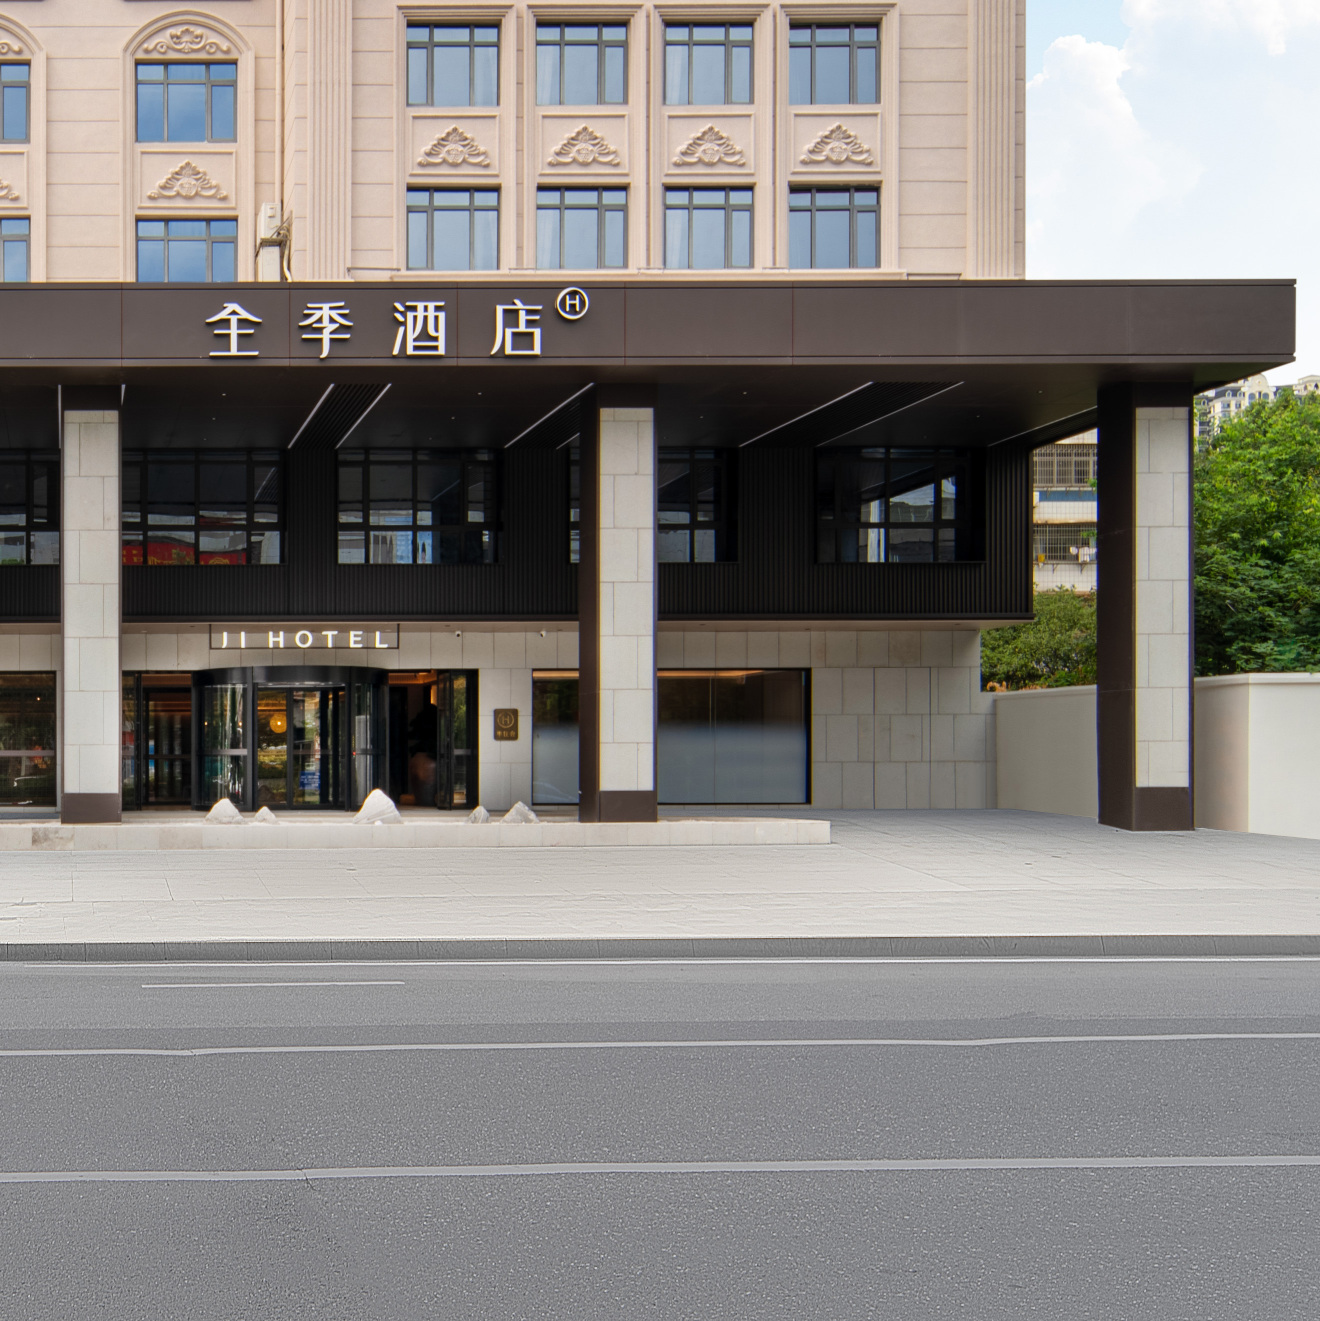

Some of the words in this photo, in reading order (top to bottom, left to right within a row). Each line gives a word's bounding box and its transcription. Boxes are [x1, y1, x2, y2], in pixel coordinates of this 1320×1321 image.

[205, 298, 543, 358] 全季酒店
[221, 630, 246, 649] JI
[268, 630, 389, 649] HOTEL
